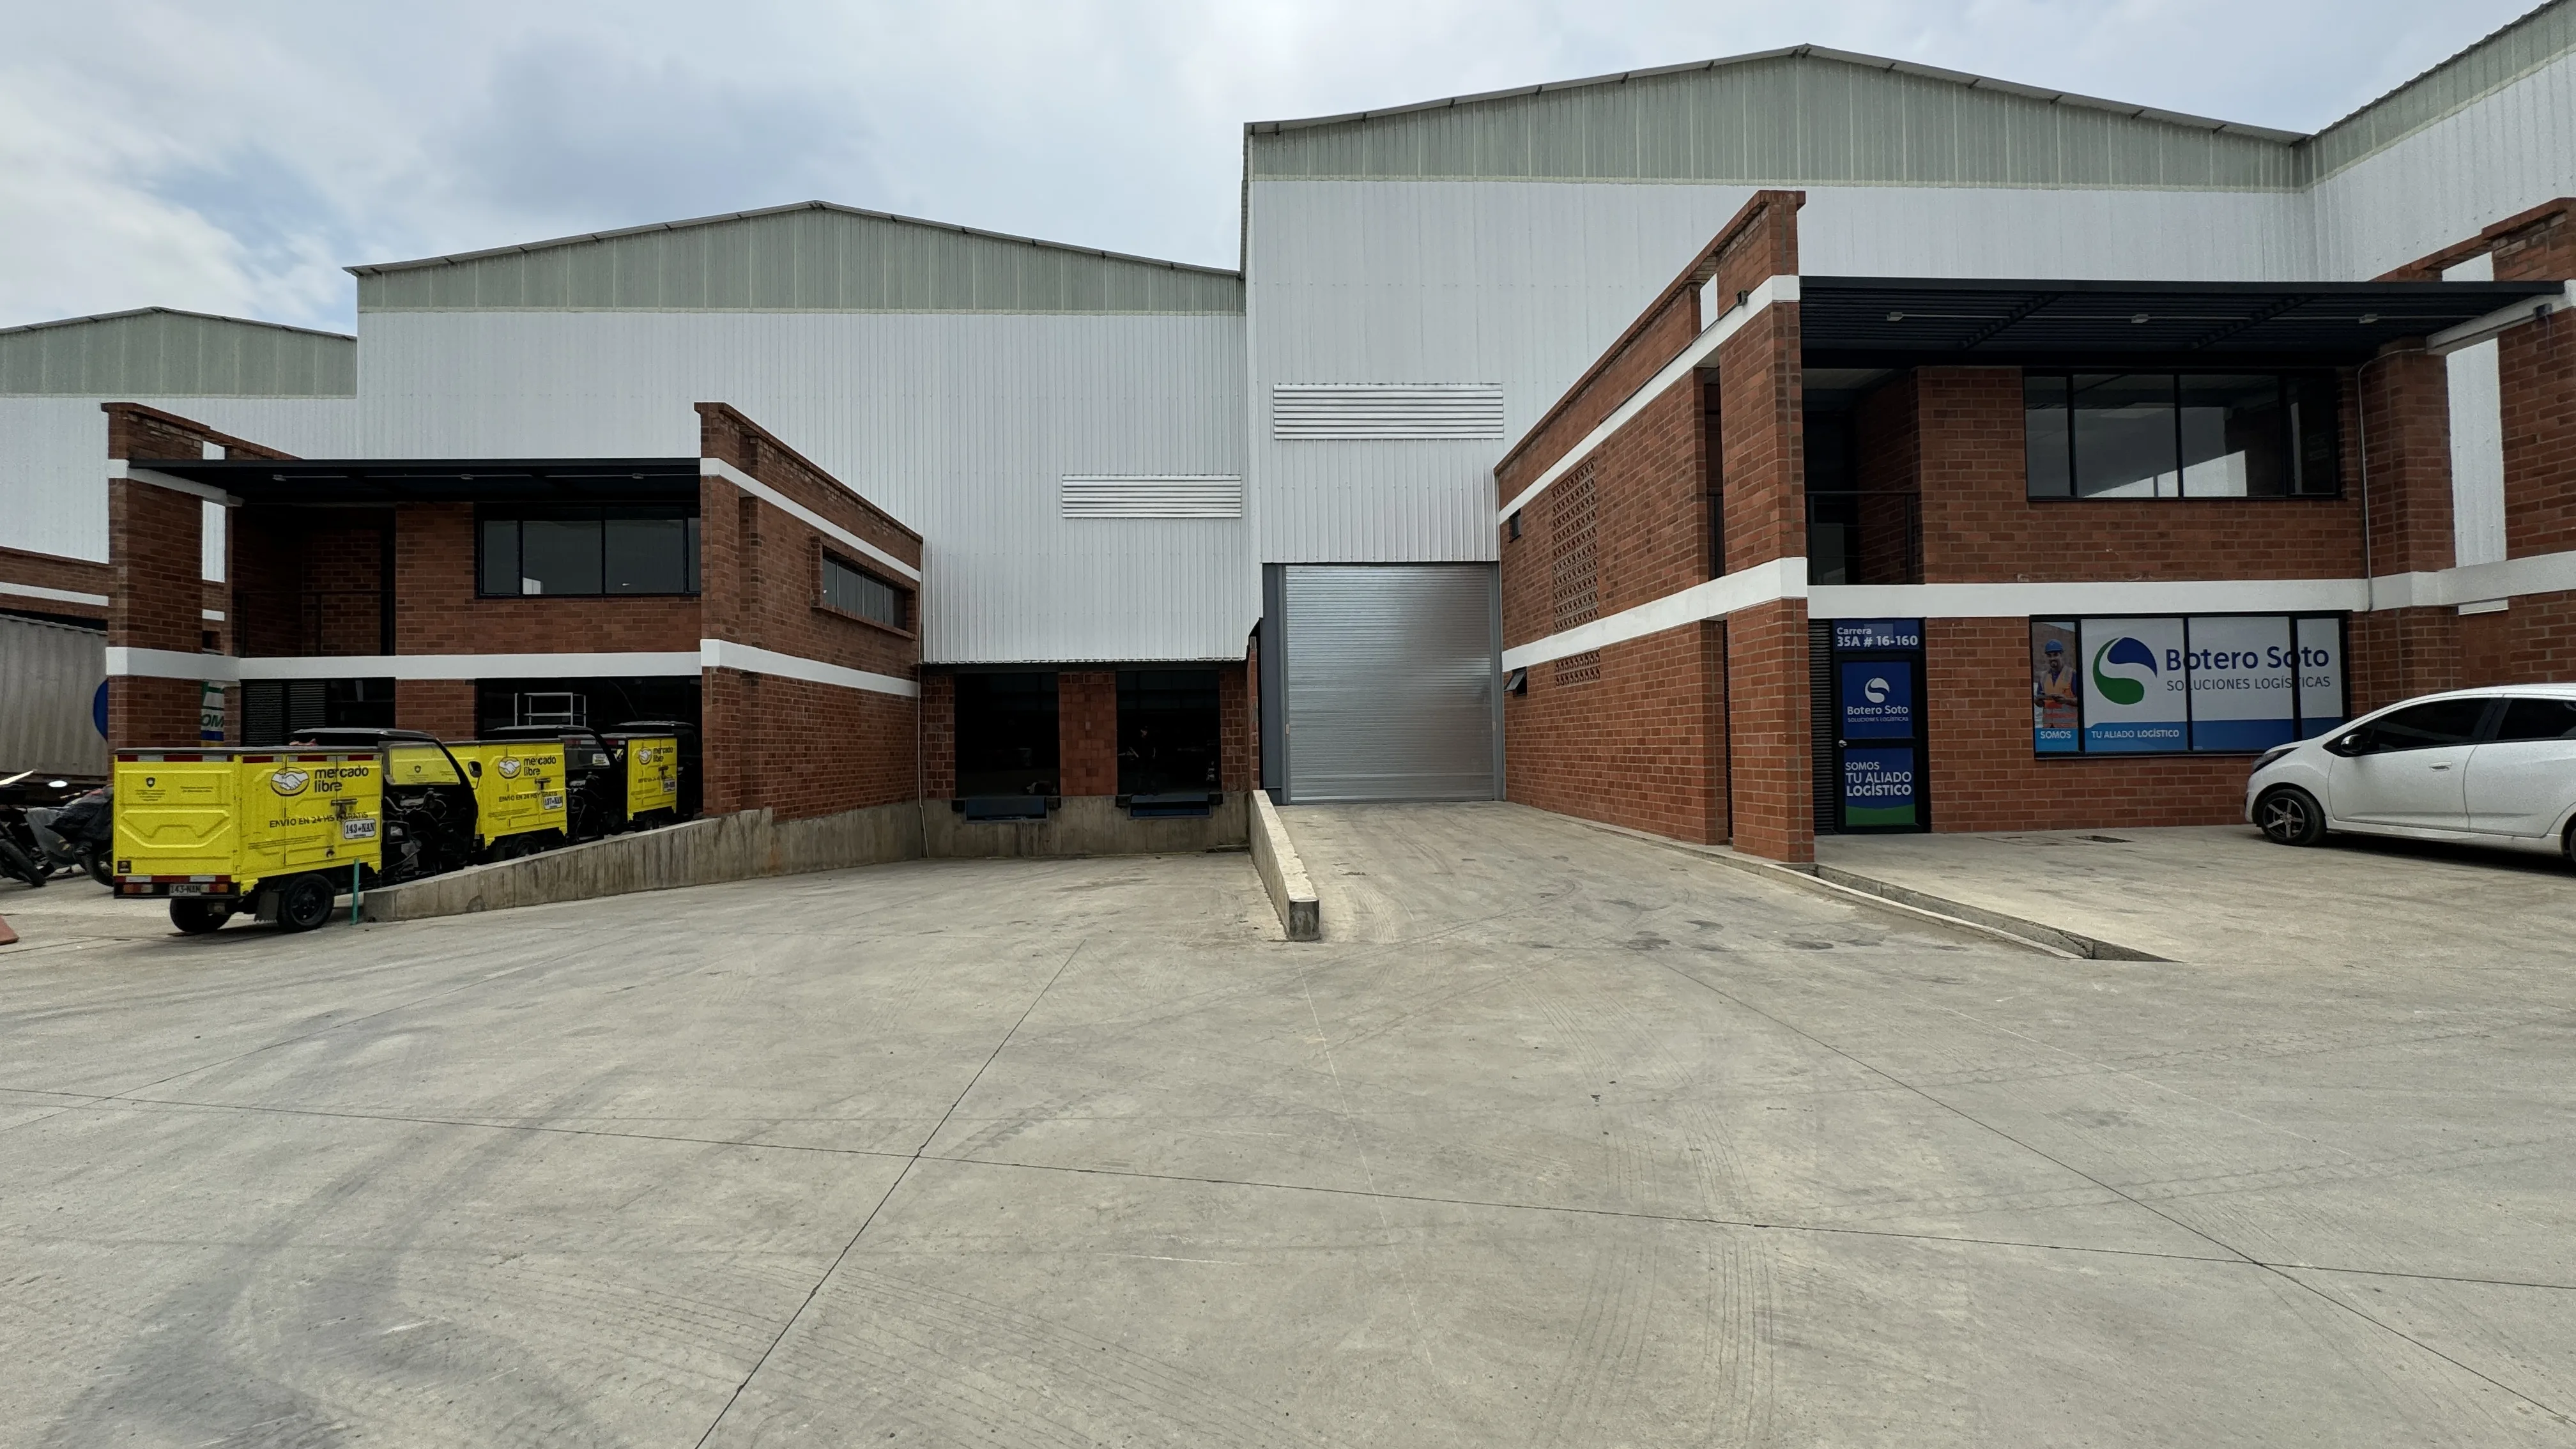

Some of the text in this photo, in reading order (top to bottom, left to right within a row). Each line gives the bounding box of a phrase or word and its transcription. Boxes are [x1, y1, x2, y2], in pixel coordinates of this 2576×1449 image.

[1837, 627, 1872, 635] Carrera
[1837, 635, 1919, 647] 35A # 16-160
[2166, 646, 2329, 671] Botero Soto
[2166, 675, 2331, 691] SOUCIONES LOGÍSICAS
[1847, 705, 1909, 715] Botero Soto
[2040, 730, 2071, 739] SOMOS
[2091, 730, 2102, 739] TU
[2137, 728, 2179, 738] LOGÍSTICO
[315, 765, 369, 779] mercado
[524, 767, 540, 776] libre
[1845, 762, 1880, 771] SOMOS
[1846, 771, 1912, 784] TU ALIADO
[314, 779, 342, 793] libre
[1846, 781, 1912, 797] LOGÍSTICO
[299, 817, 310, 825] EN
